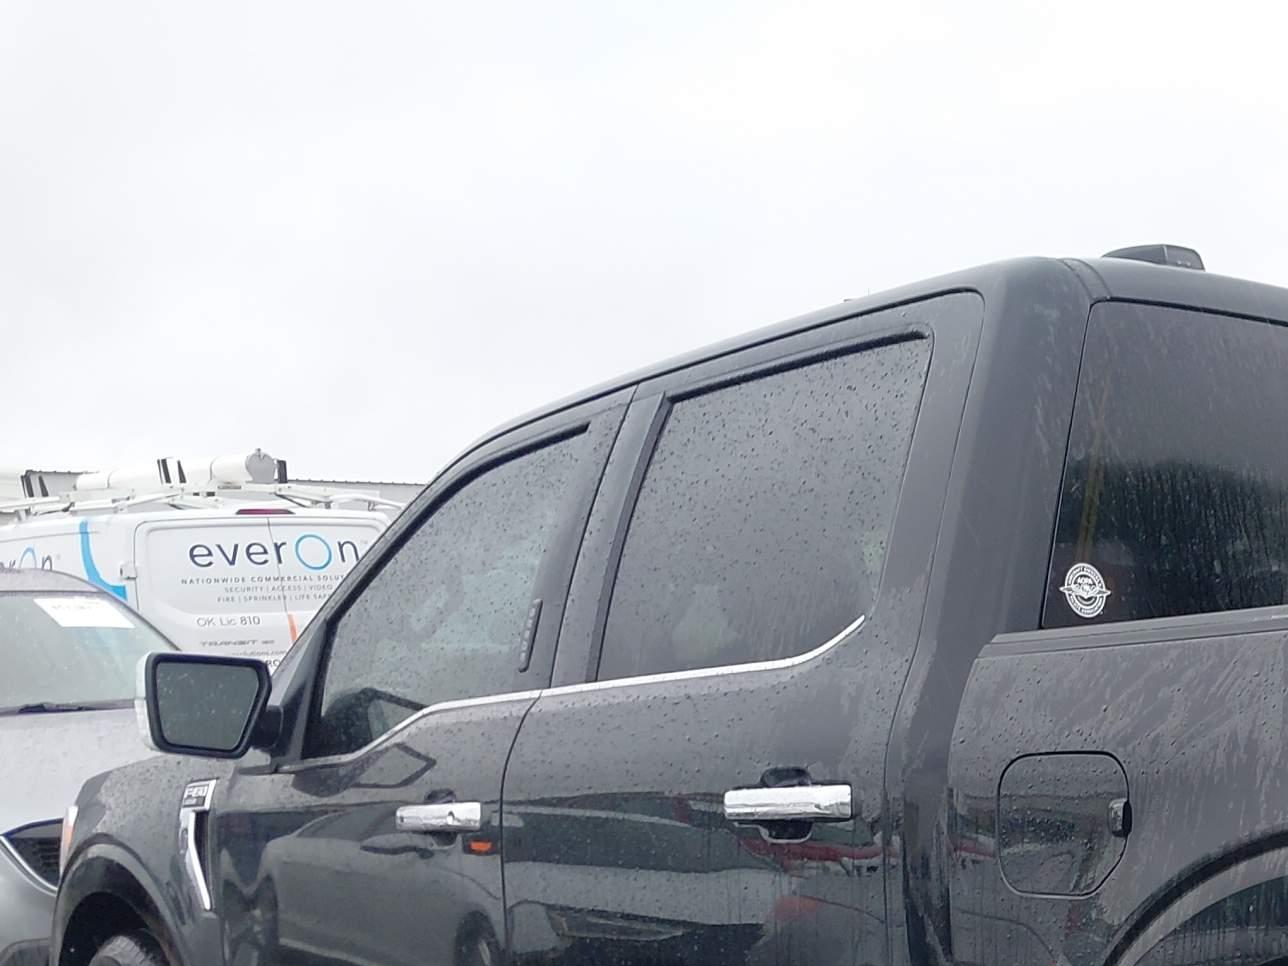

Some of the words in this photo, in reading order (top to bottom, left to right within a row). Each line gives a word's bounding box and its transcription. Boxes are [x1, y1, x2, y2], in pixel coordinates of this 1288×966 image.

[181, 577, 246, 585] NATIONWIDE
[251, 575, 314, 583] COMMERCIAL
[197, 616, 216, 627] OK
[240, 616, 261, 626] 810
